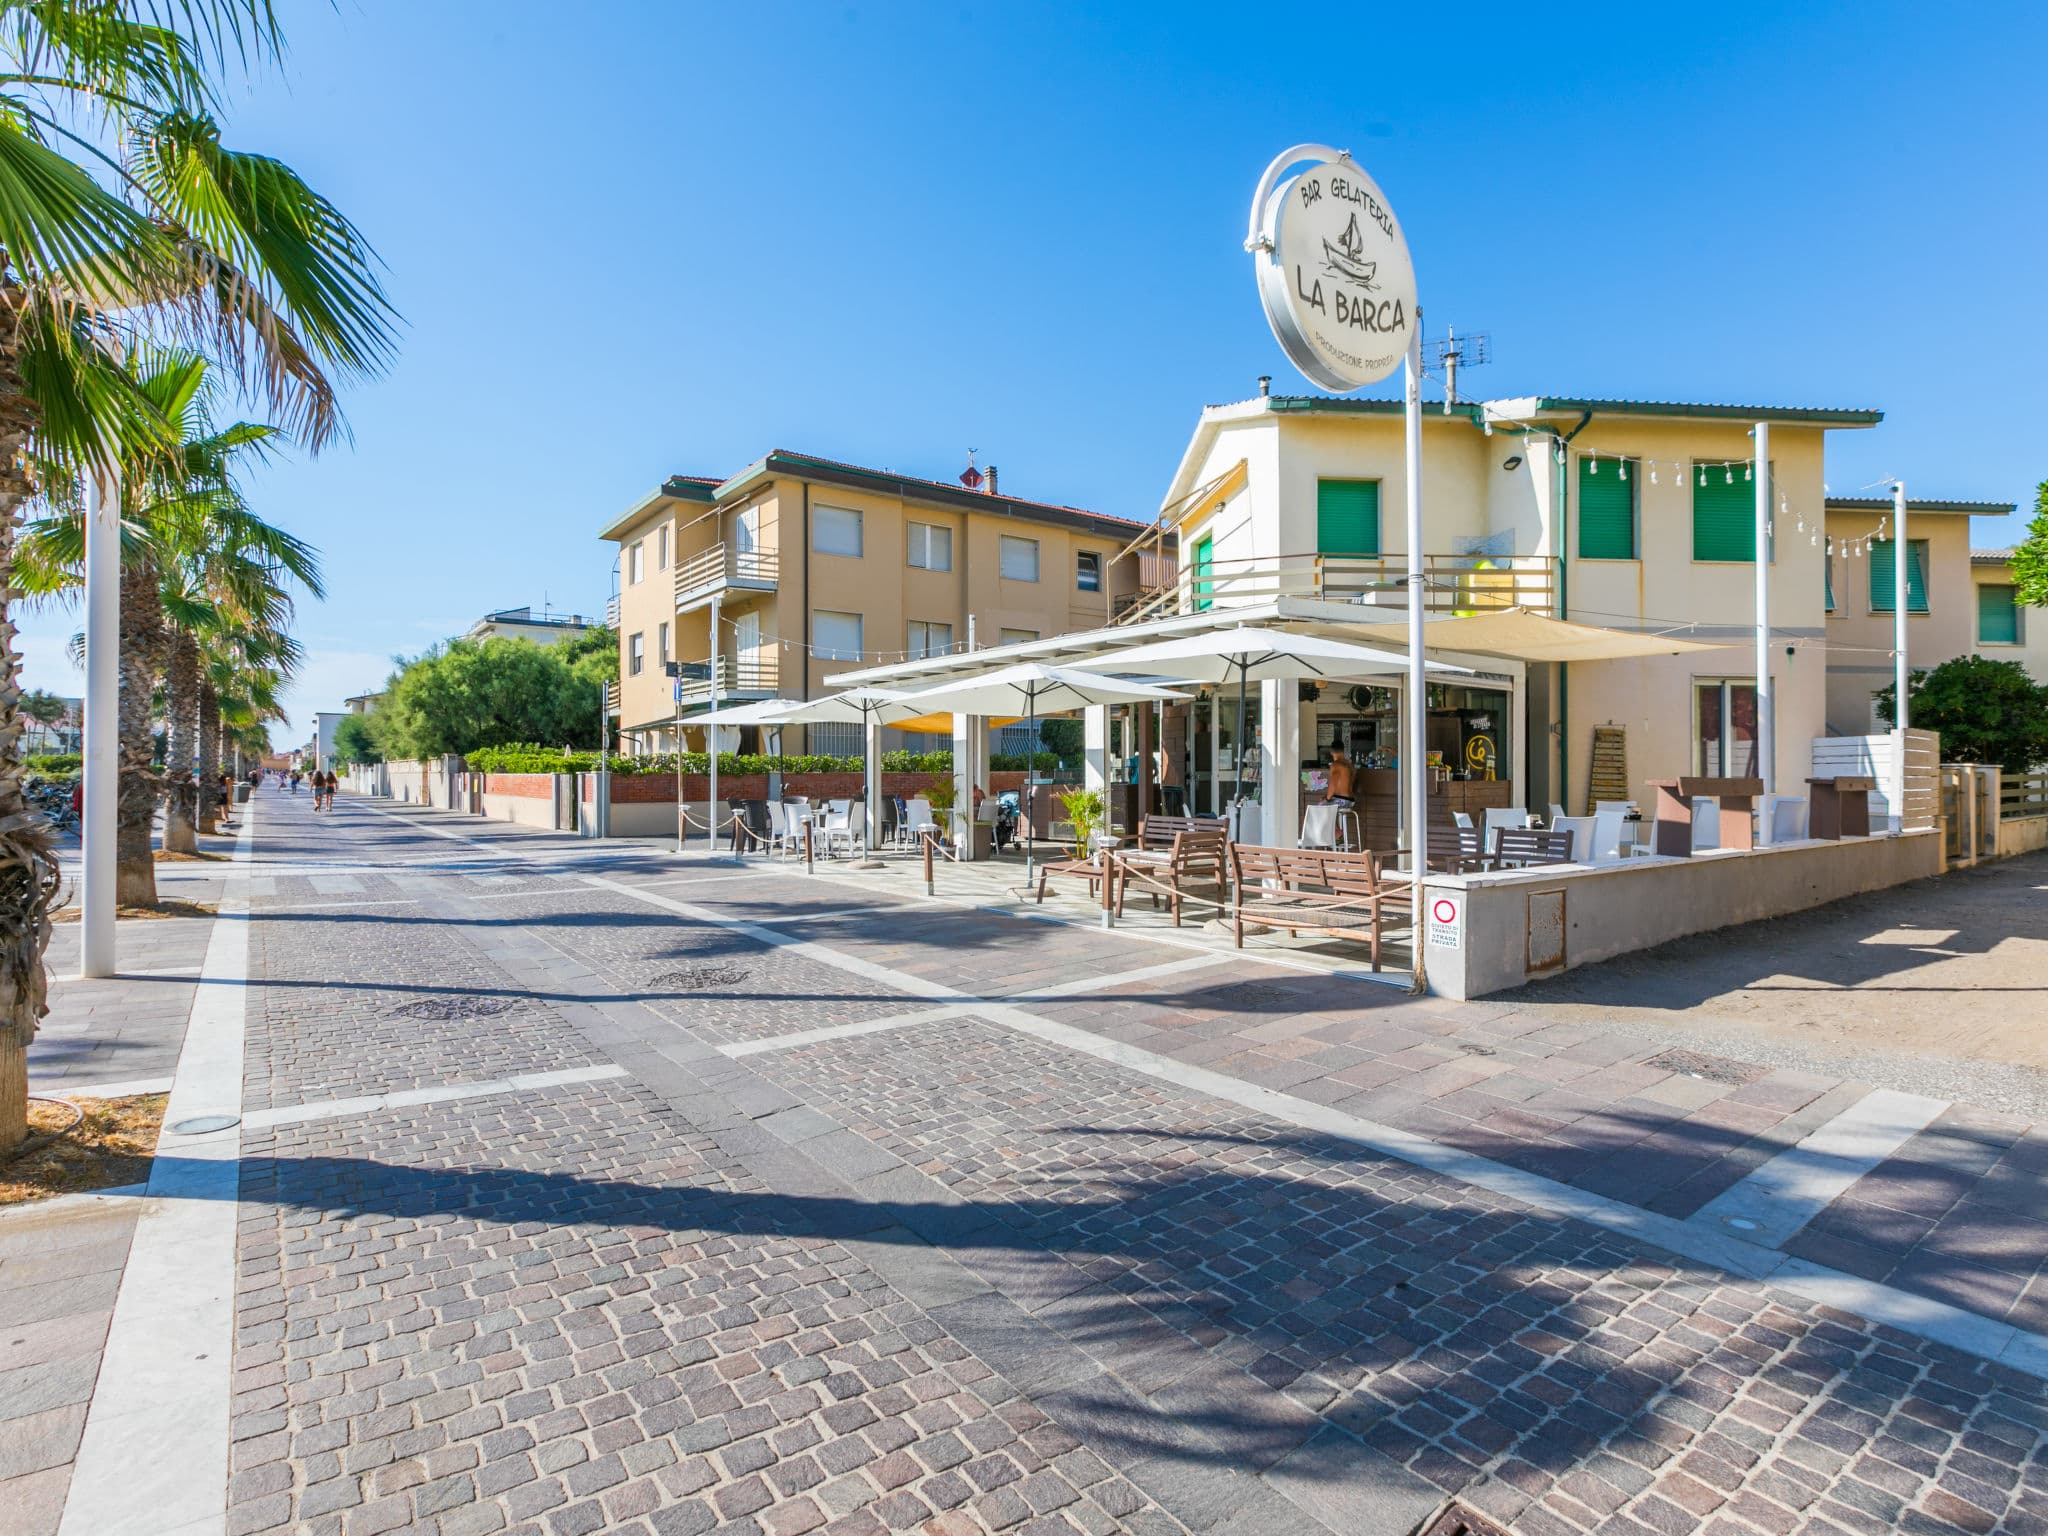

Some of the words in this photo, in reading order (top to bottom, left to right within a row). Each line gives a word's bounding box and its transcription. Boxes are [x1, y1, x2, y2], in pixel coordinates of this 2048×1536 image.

[1301, 178, 1322, 209] BAR
[1331, 176, 1394, 242] GELATERIA
[1297, 264, 1326, 316] LA
[1335, 291, 1406, 333] BARCA
[1315, 330, 1363, 369] PRODUZIONE
[1364, 354, 1394, 370] PROPRIA
[1432, 934, 1456, 942] STRADA
